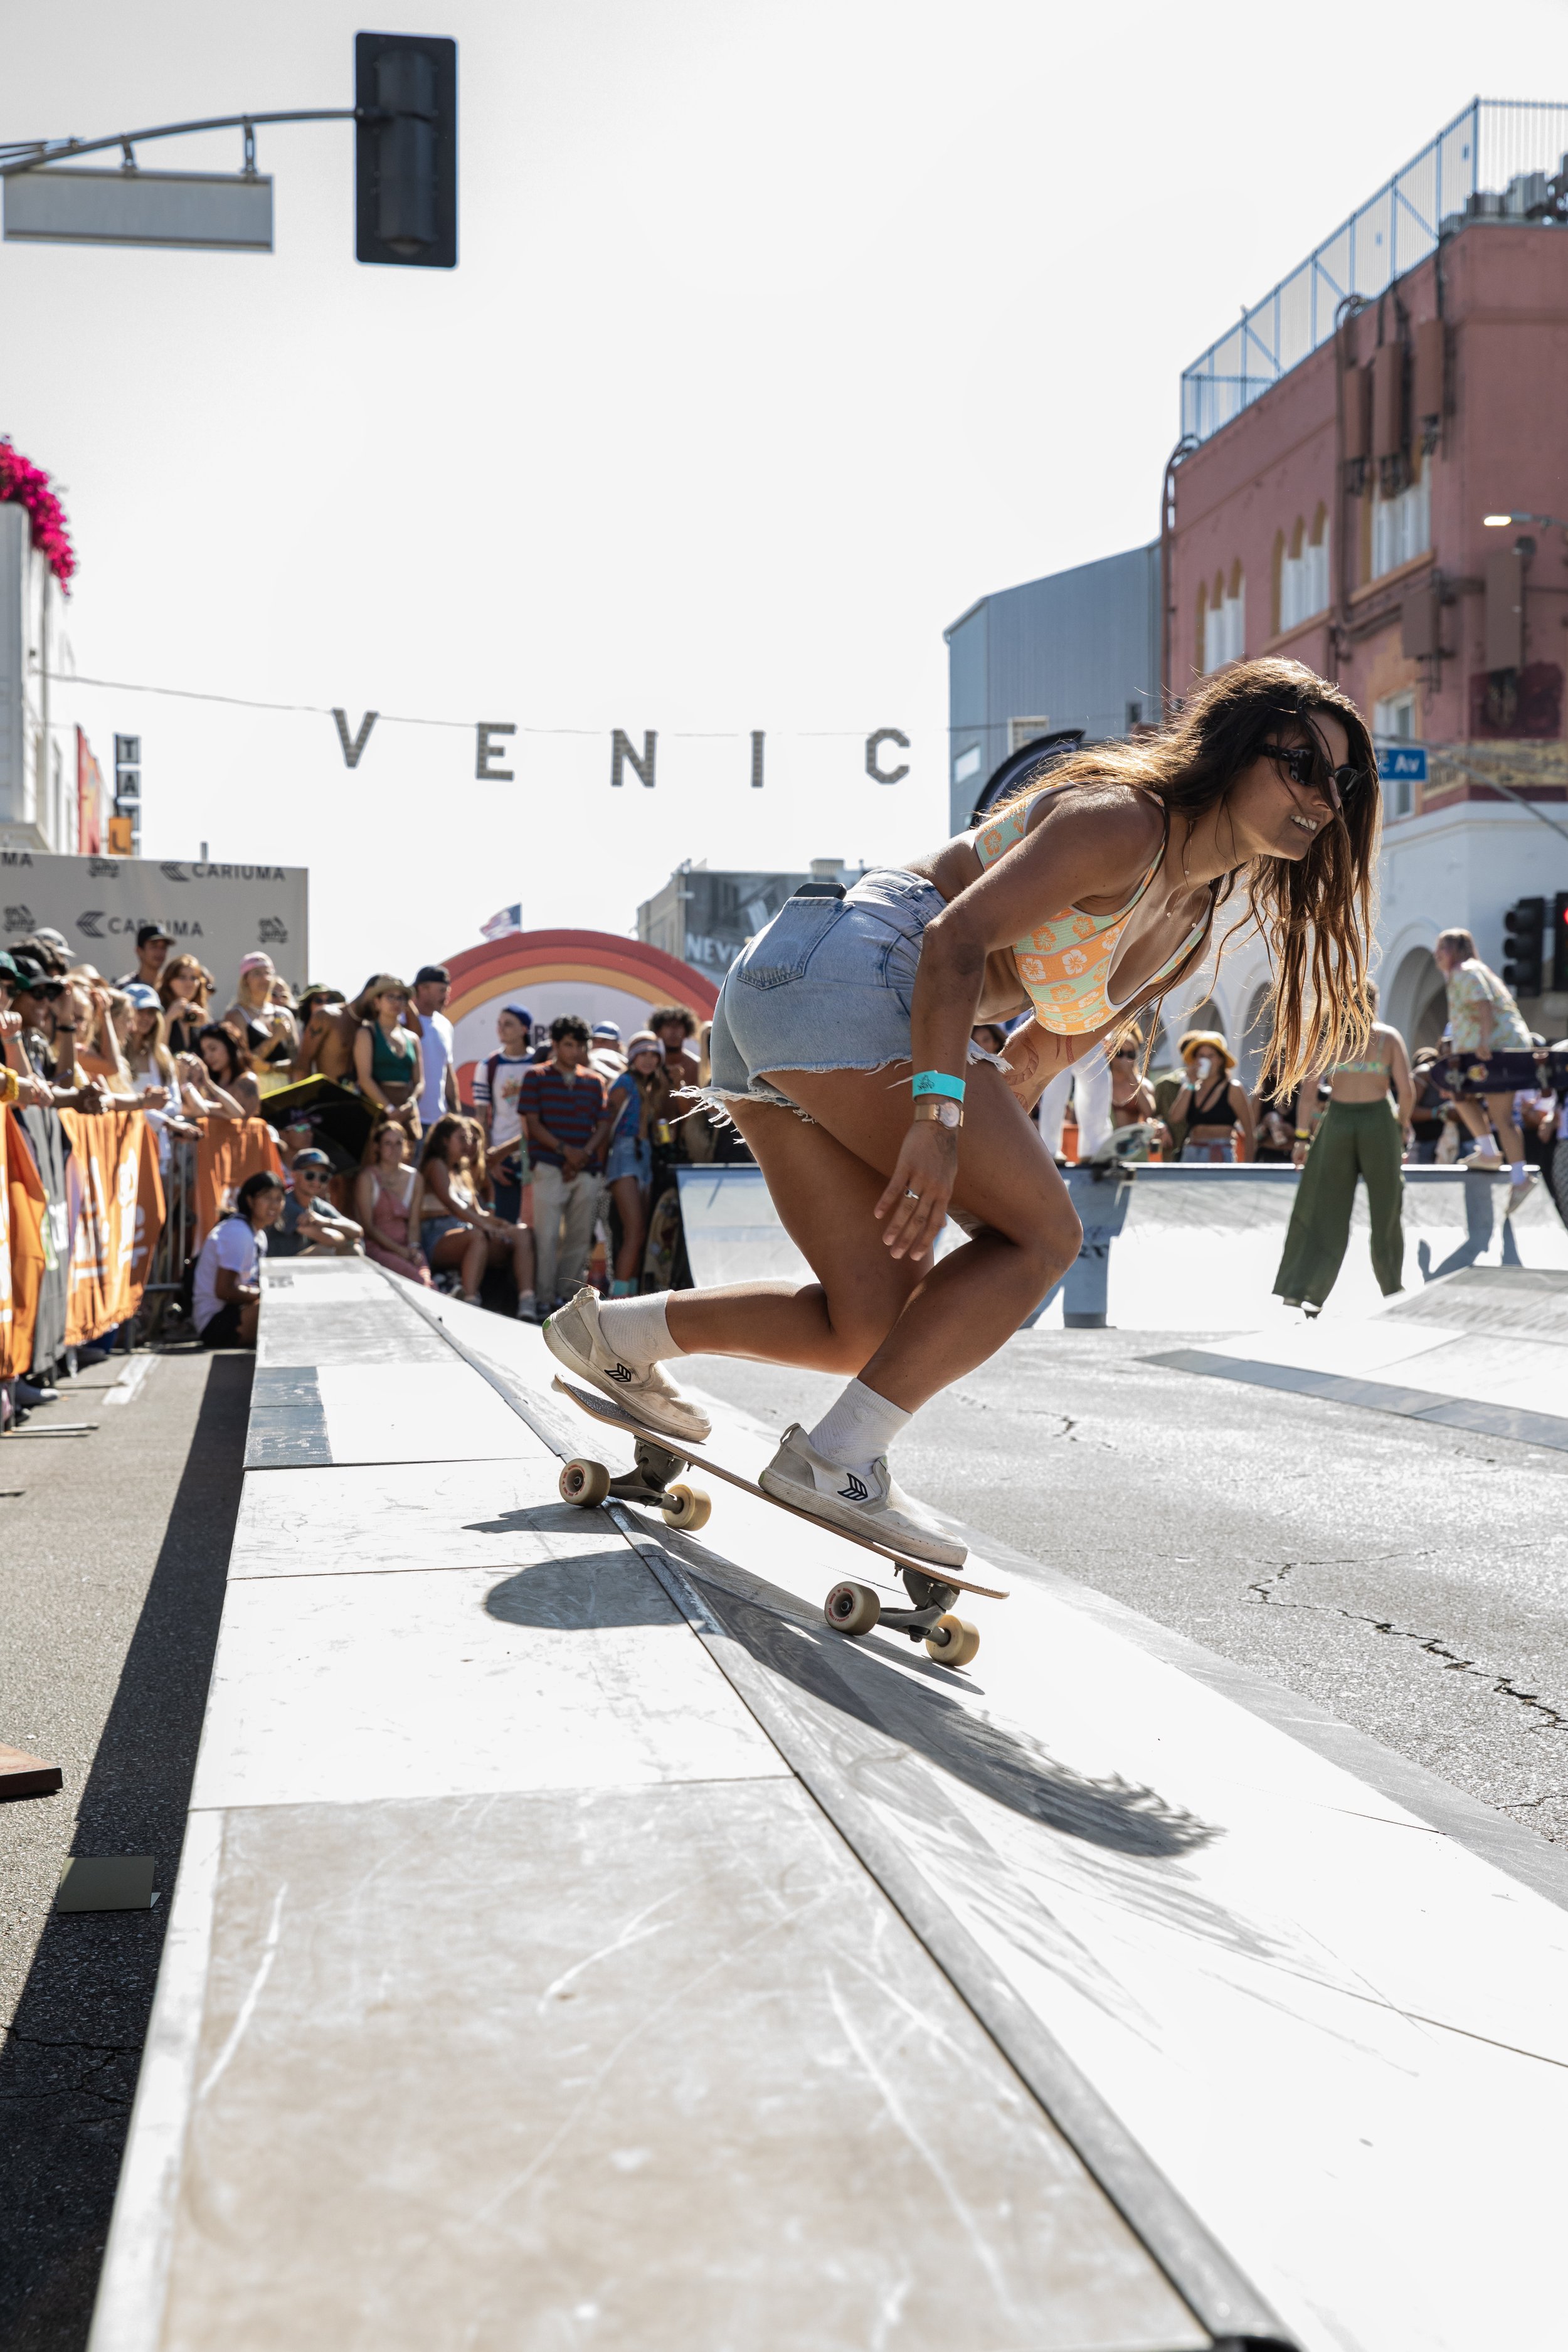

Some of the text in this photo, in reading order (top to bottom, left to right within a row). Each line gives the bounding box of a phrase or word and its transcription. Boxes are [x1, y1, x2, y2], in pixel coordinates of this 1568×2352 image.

[1394, 753, 1420, 773] Av
[191, 862, 286, 882] CARIUMA
[107, 916, 204, 938] CAMA
